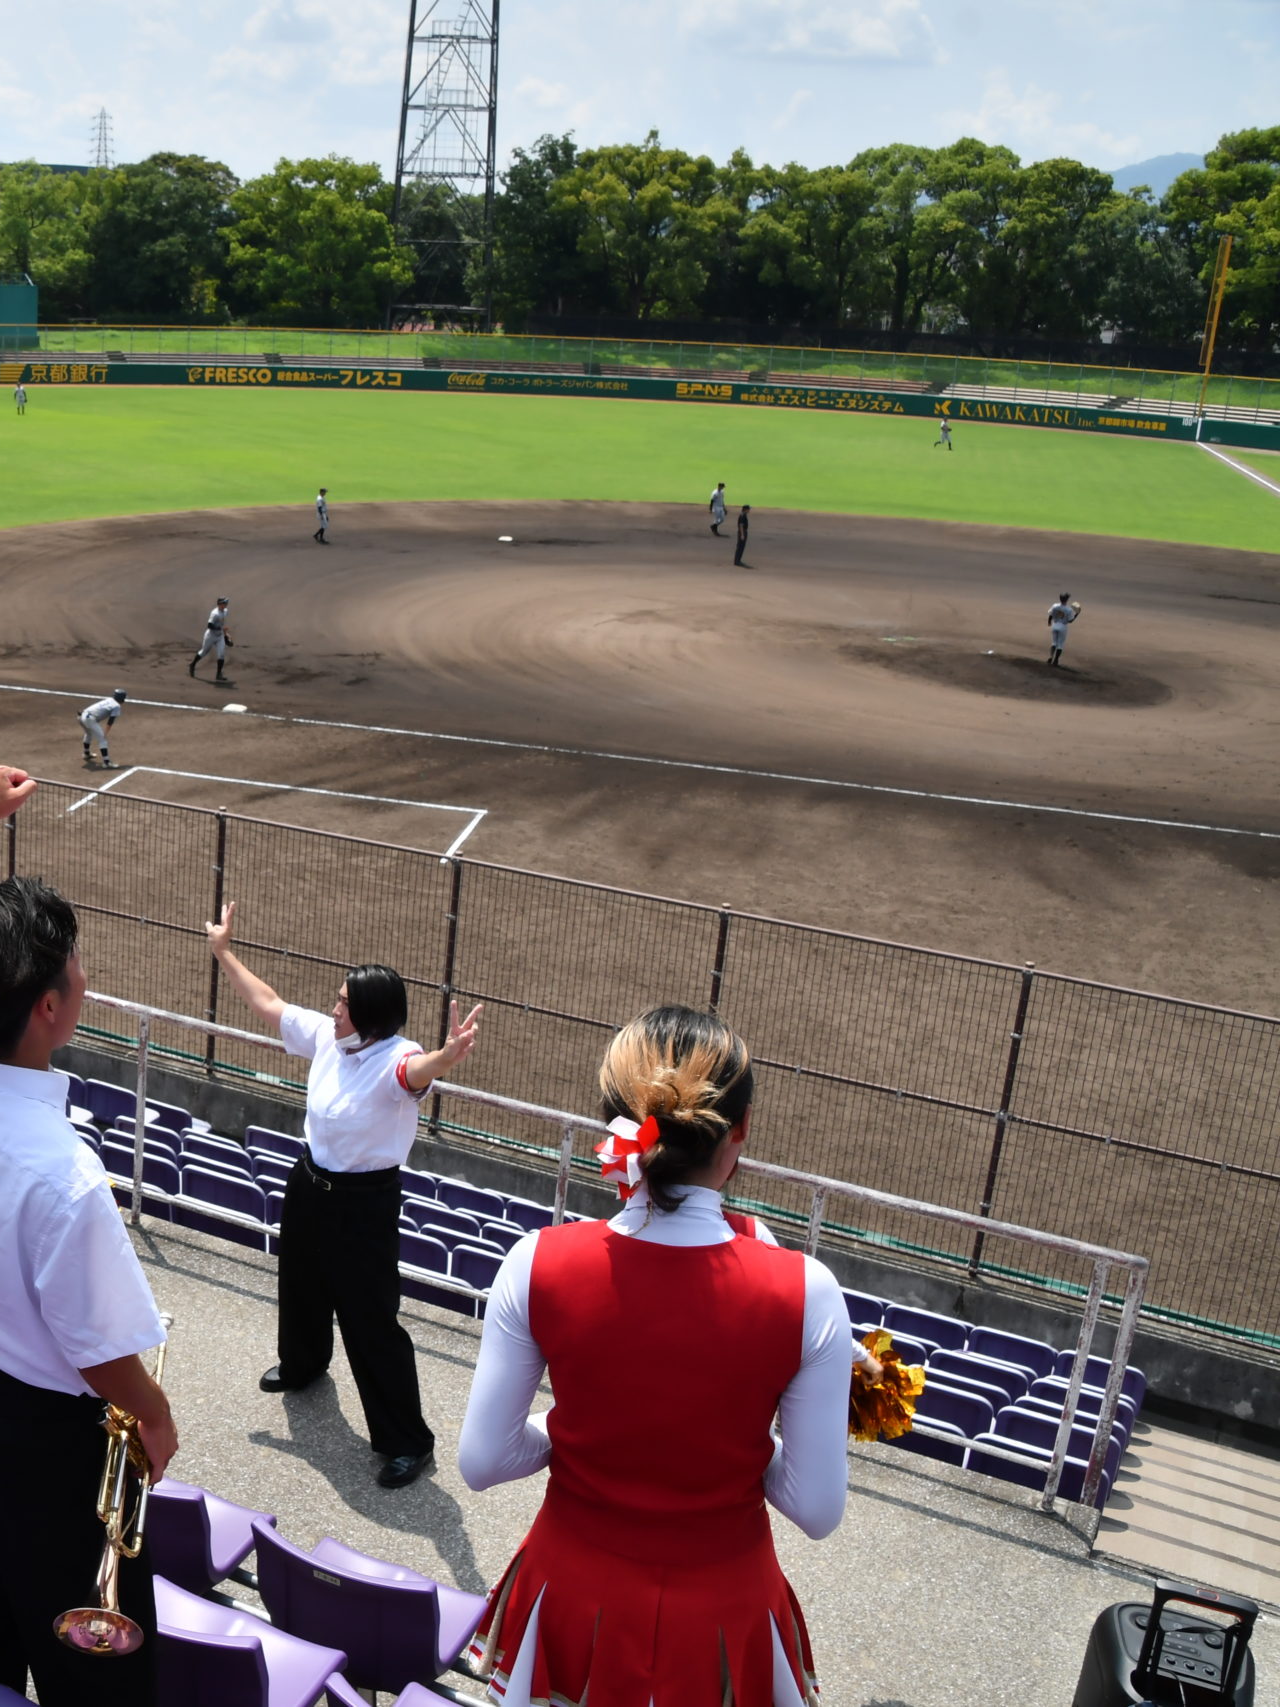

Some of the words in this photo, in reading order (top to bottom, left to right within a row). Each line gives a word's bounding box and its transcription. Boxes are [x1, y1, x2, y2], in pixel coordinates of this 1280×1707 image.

[30, 364, 108, 383] 京都銀行
[204, 367, 272, 384] FRESCO
[339, 369, 402, 386] フレスコ
[447, 372, 488, 386] Coca-Cola
[740, 393, 774, 403] 株式会社
[959, 401, 1077, 426] KAWAKATSU
[1077, 417, 1096, 428] Inc.
